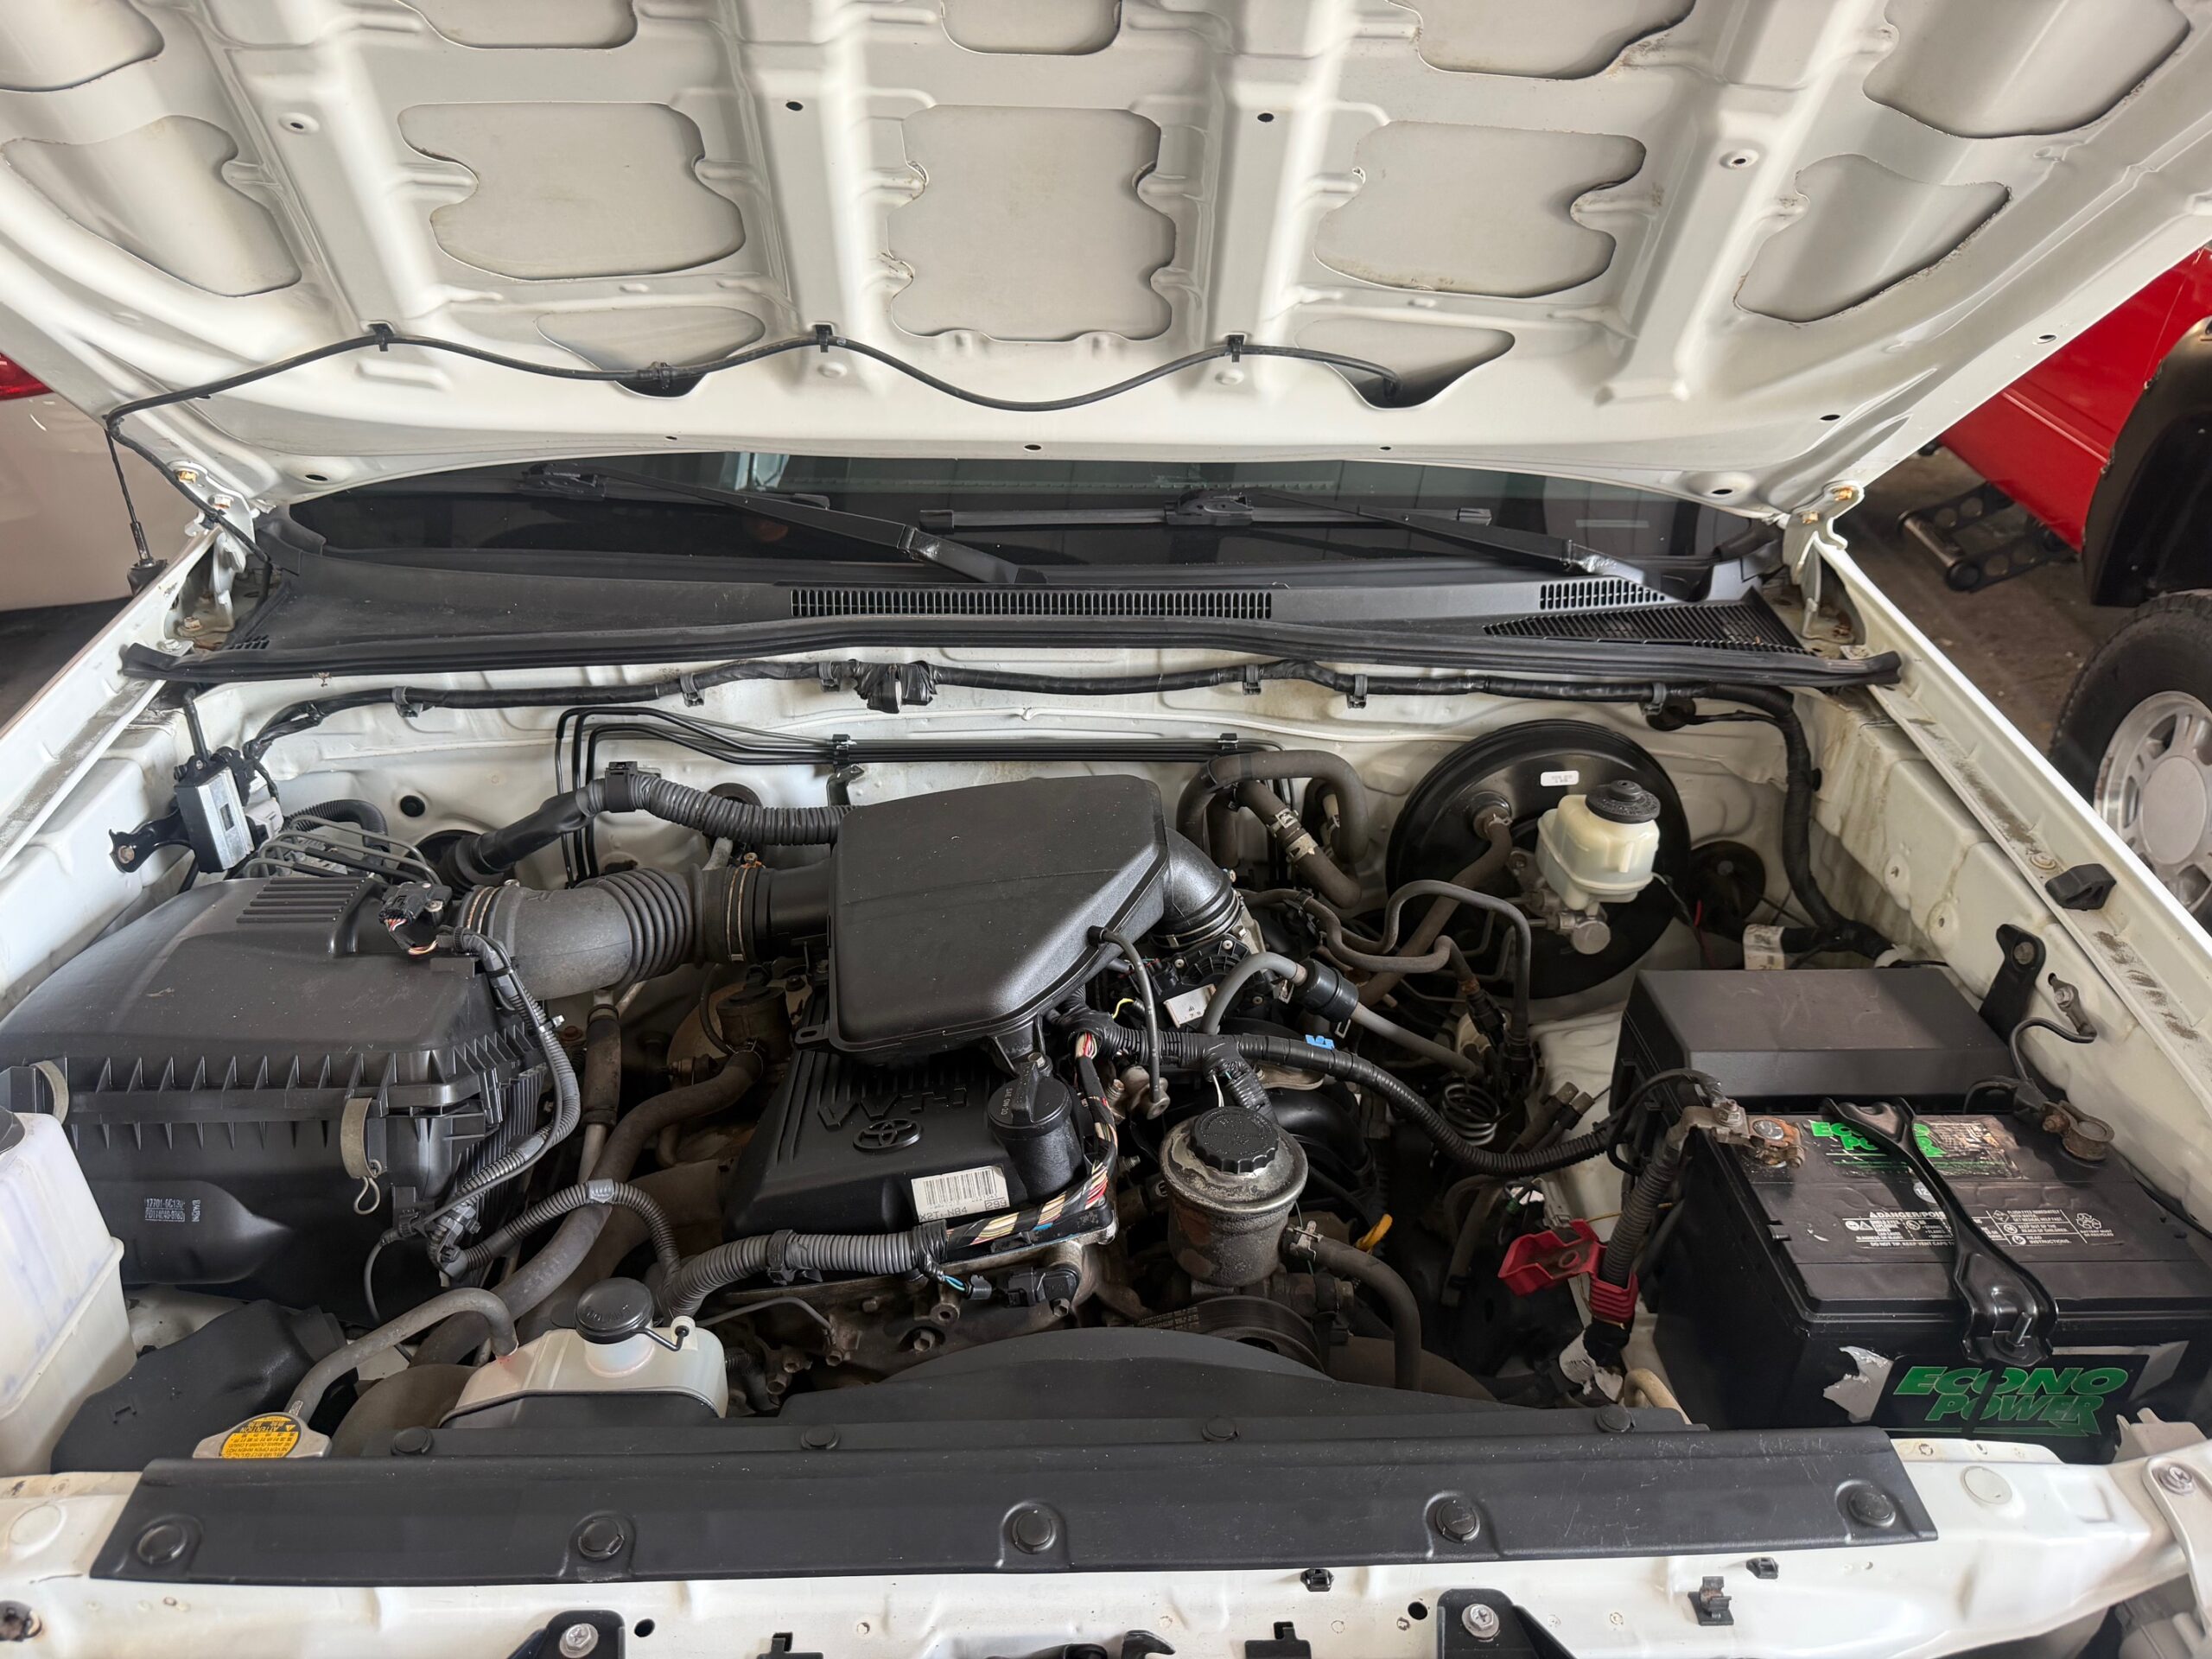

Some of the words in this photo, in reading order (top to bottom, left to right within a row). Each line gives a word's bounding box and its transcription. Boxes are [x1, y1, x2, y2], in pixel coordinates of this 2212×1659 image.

[1001, 1098, 1011, 1116] 0W-20
[986, 1199, 1007, 1211] 299
[1893, 1366, 2129, 1395] ECONO
[1924, 1395, 2104, 1435] POWER
